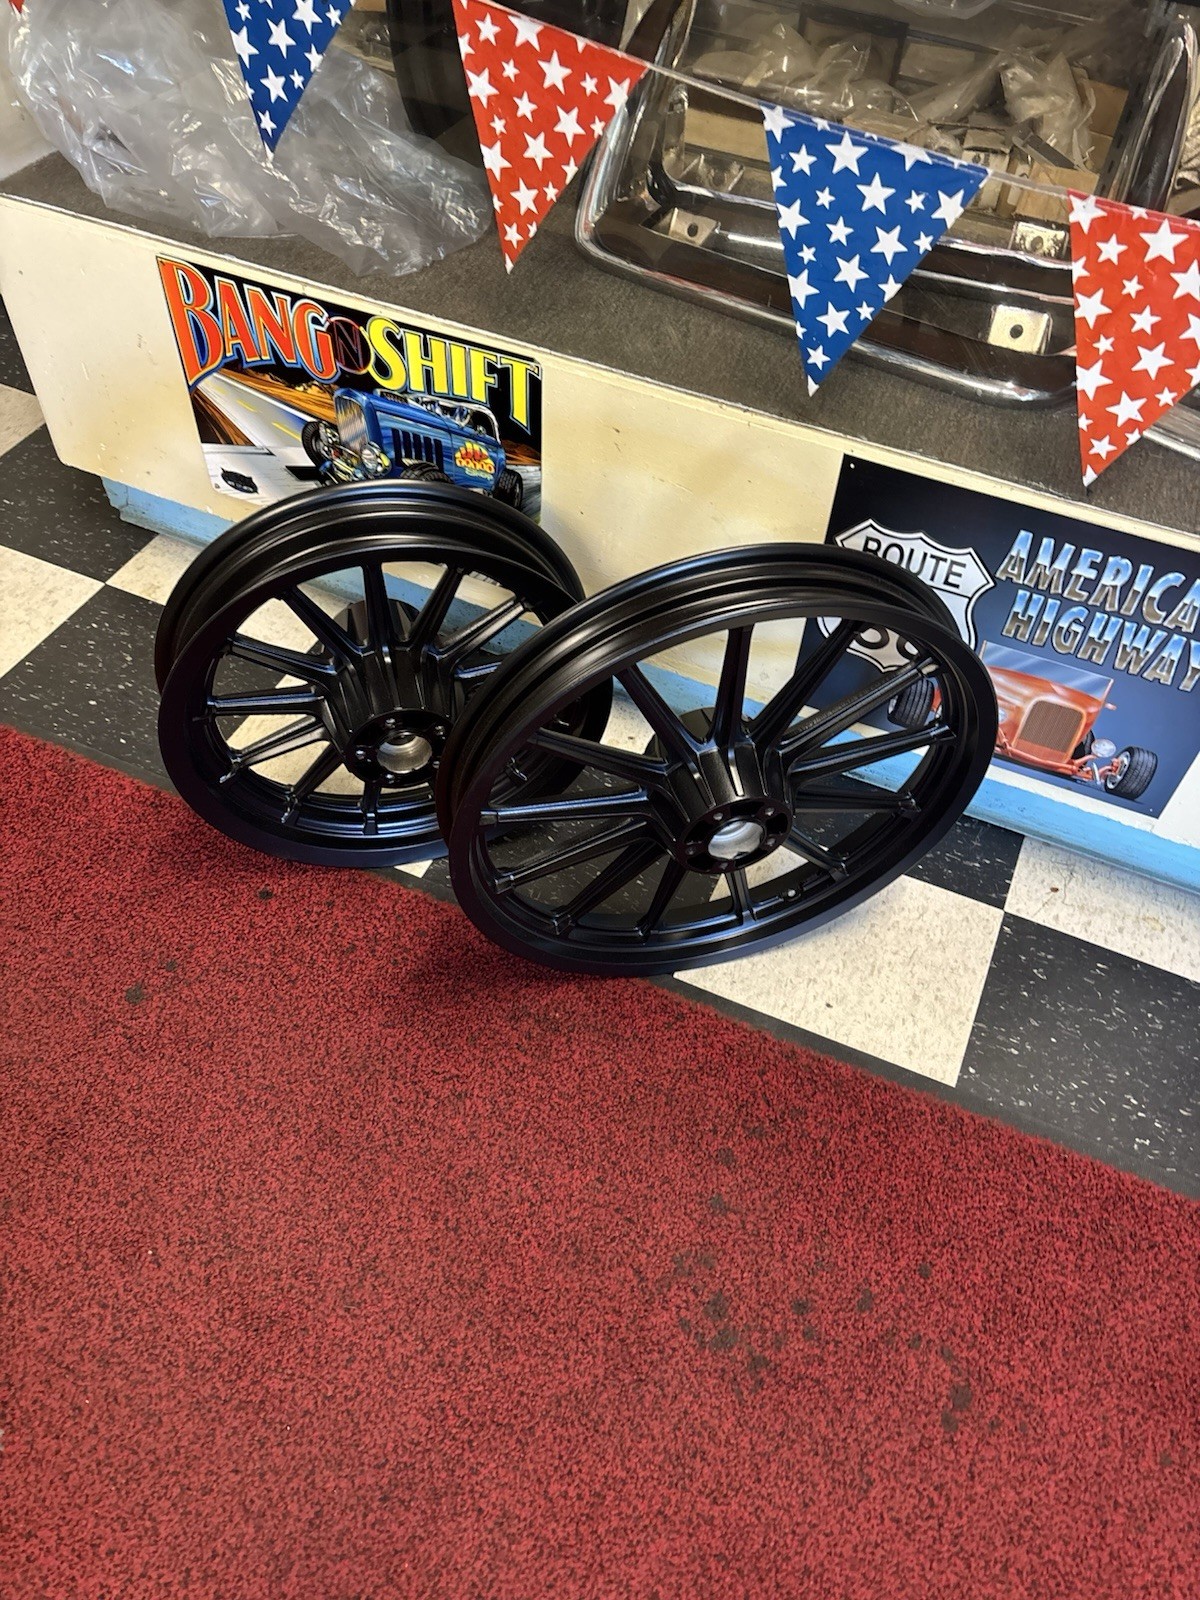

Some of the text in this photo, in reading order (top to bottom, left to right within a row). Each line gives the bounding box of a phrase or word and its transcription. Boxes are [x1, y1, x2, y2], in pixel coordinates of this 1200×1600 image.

[157, 256, 340, 385] BANG
[365, 316, 541, 433] SHIFT
[862, 536, 967, 589] ROUTE
[996, 530, 1200, 633] AMERICA
[1002, 589, 1200, 691] HIGHWAY
